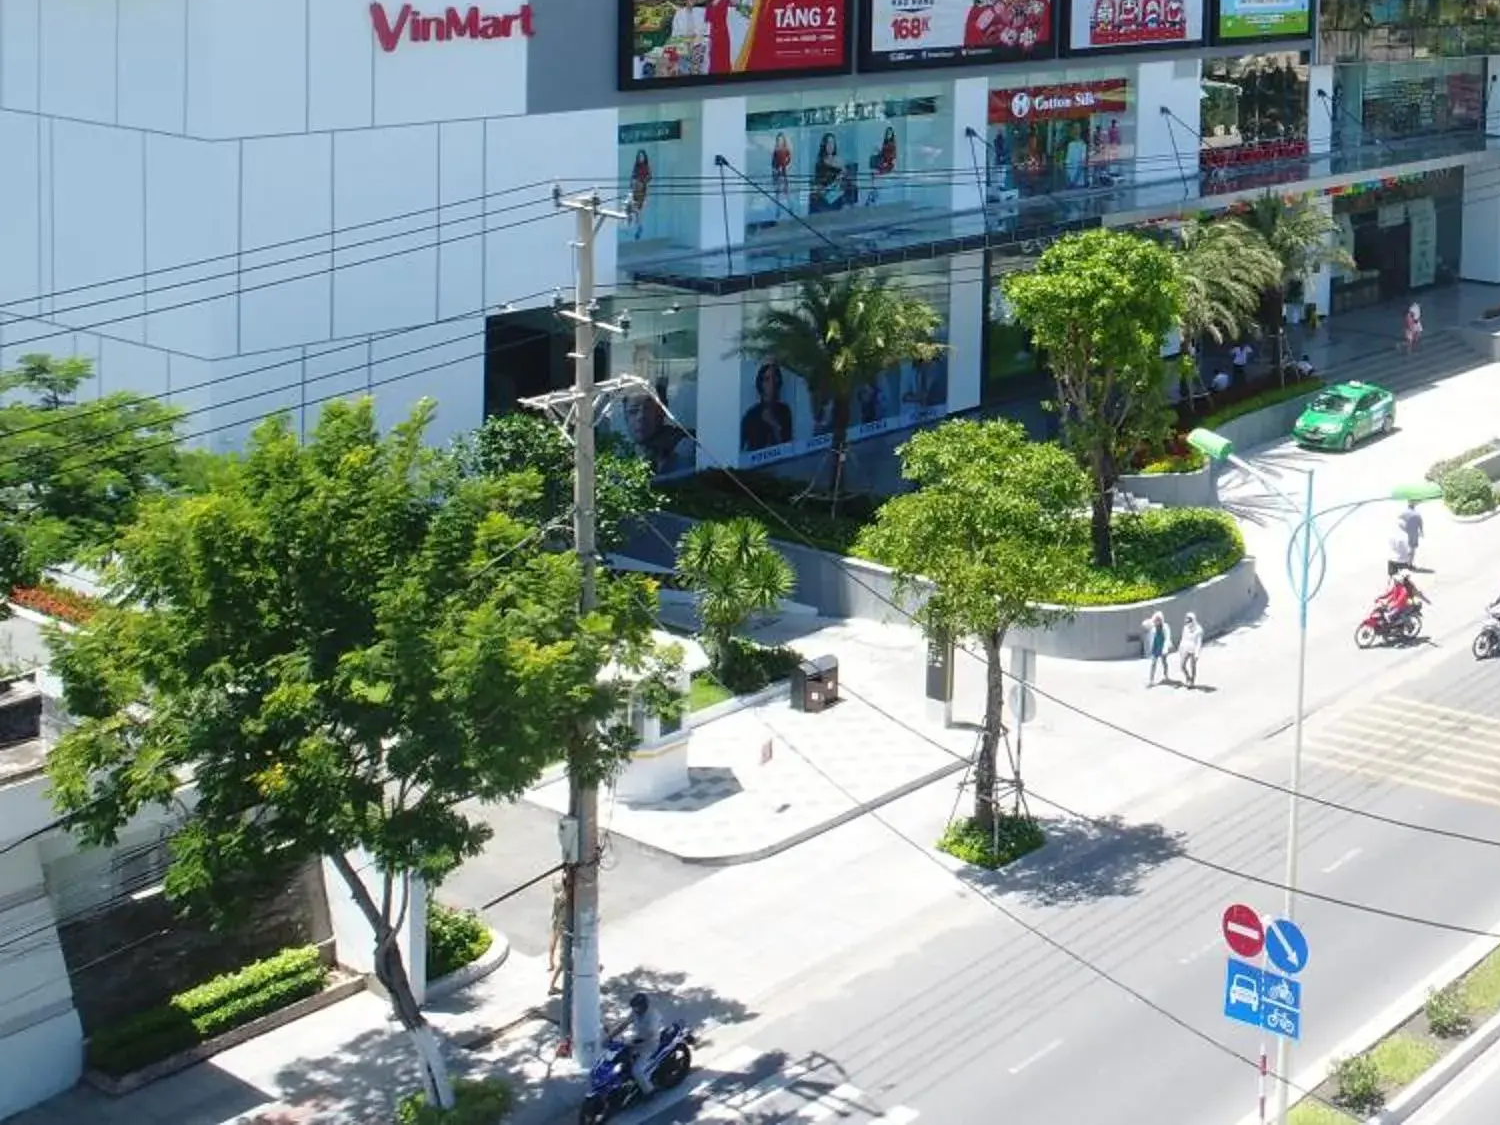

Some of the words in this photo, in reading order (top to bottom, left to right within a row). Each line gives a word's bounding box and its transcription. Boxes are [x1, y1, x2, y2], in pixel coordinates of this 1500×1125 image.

[826, 6, 837, 26] 2
[369, 2, 537, 53] VinMart
[1034, 94, 1072, 111] Cotton
